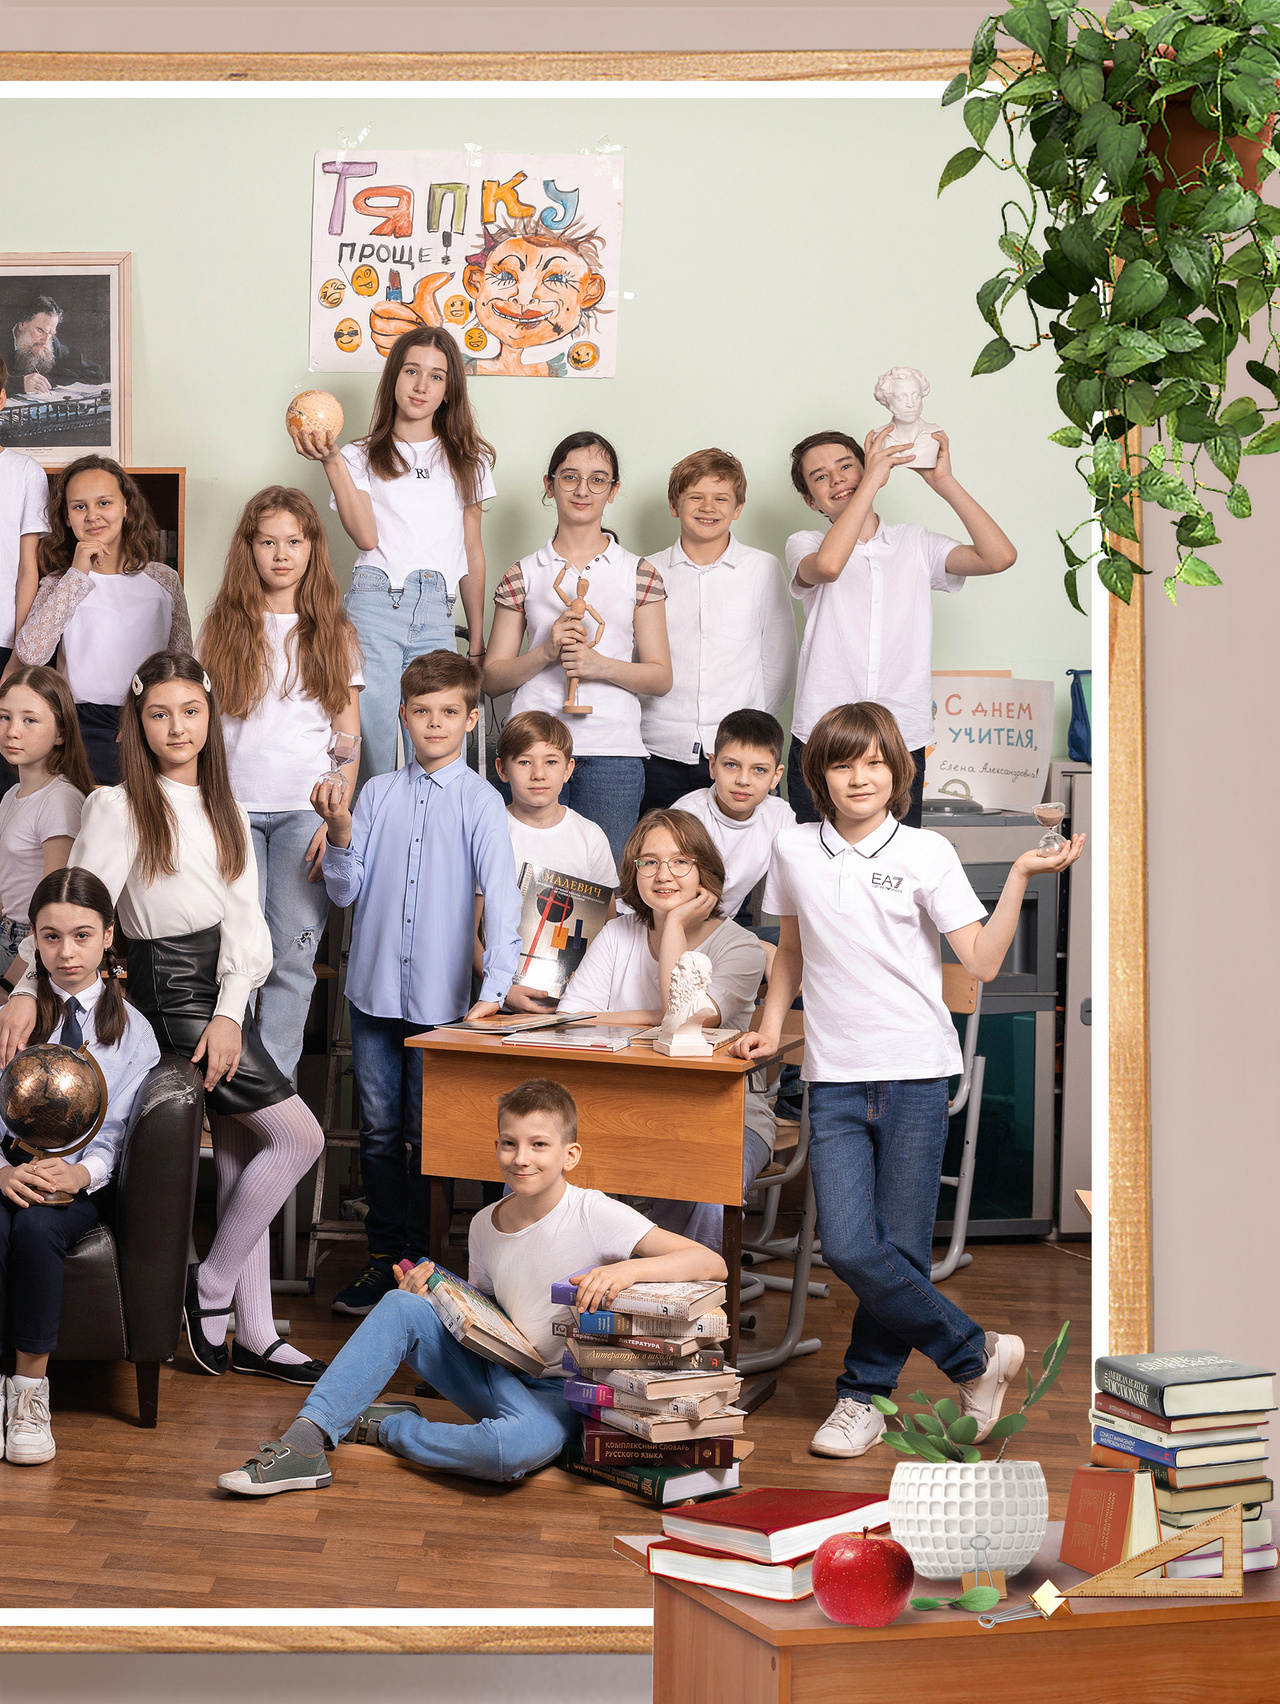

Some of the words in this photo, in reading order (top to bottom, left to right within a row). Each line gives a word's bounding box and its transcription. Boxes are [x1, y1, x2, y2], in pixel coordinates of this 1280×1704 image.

[945, 694, 962, 716] С
[971, 702, 1033, 721] ДНЕМ
[939, 760, 976, 773] Елена
[543, 872, 602, 898] МАЛЕВИЧ
[871, 872, 904, 889] EA7
[618, 1337, 661, 1350] ЛИТЕРАТУРА
[586, 1350, 640, 1361] Литература
[1108, 1379, 1149, 1407] DICTIONARY
[605, 1441, 658, 1450] КОМПЛЕКСНЫЙ
[659, 1443, 690, 1451] СЛОВАРЬ
